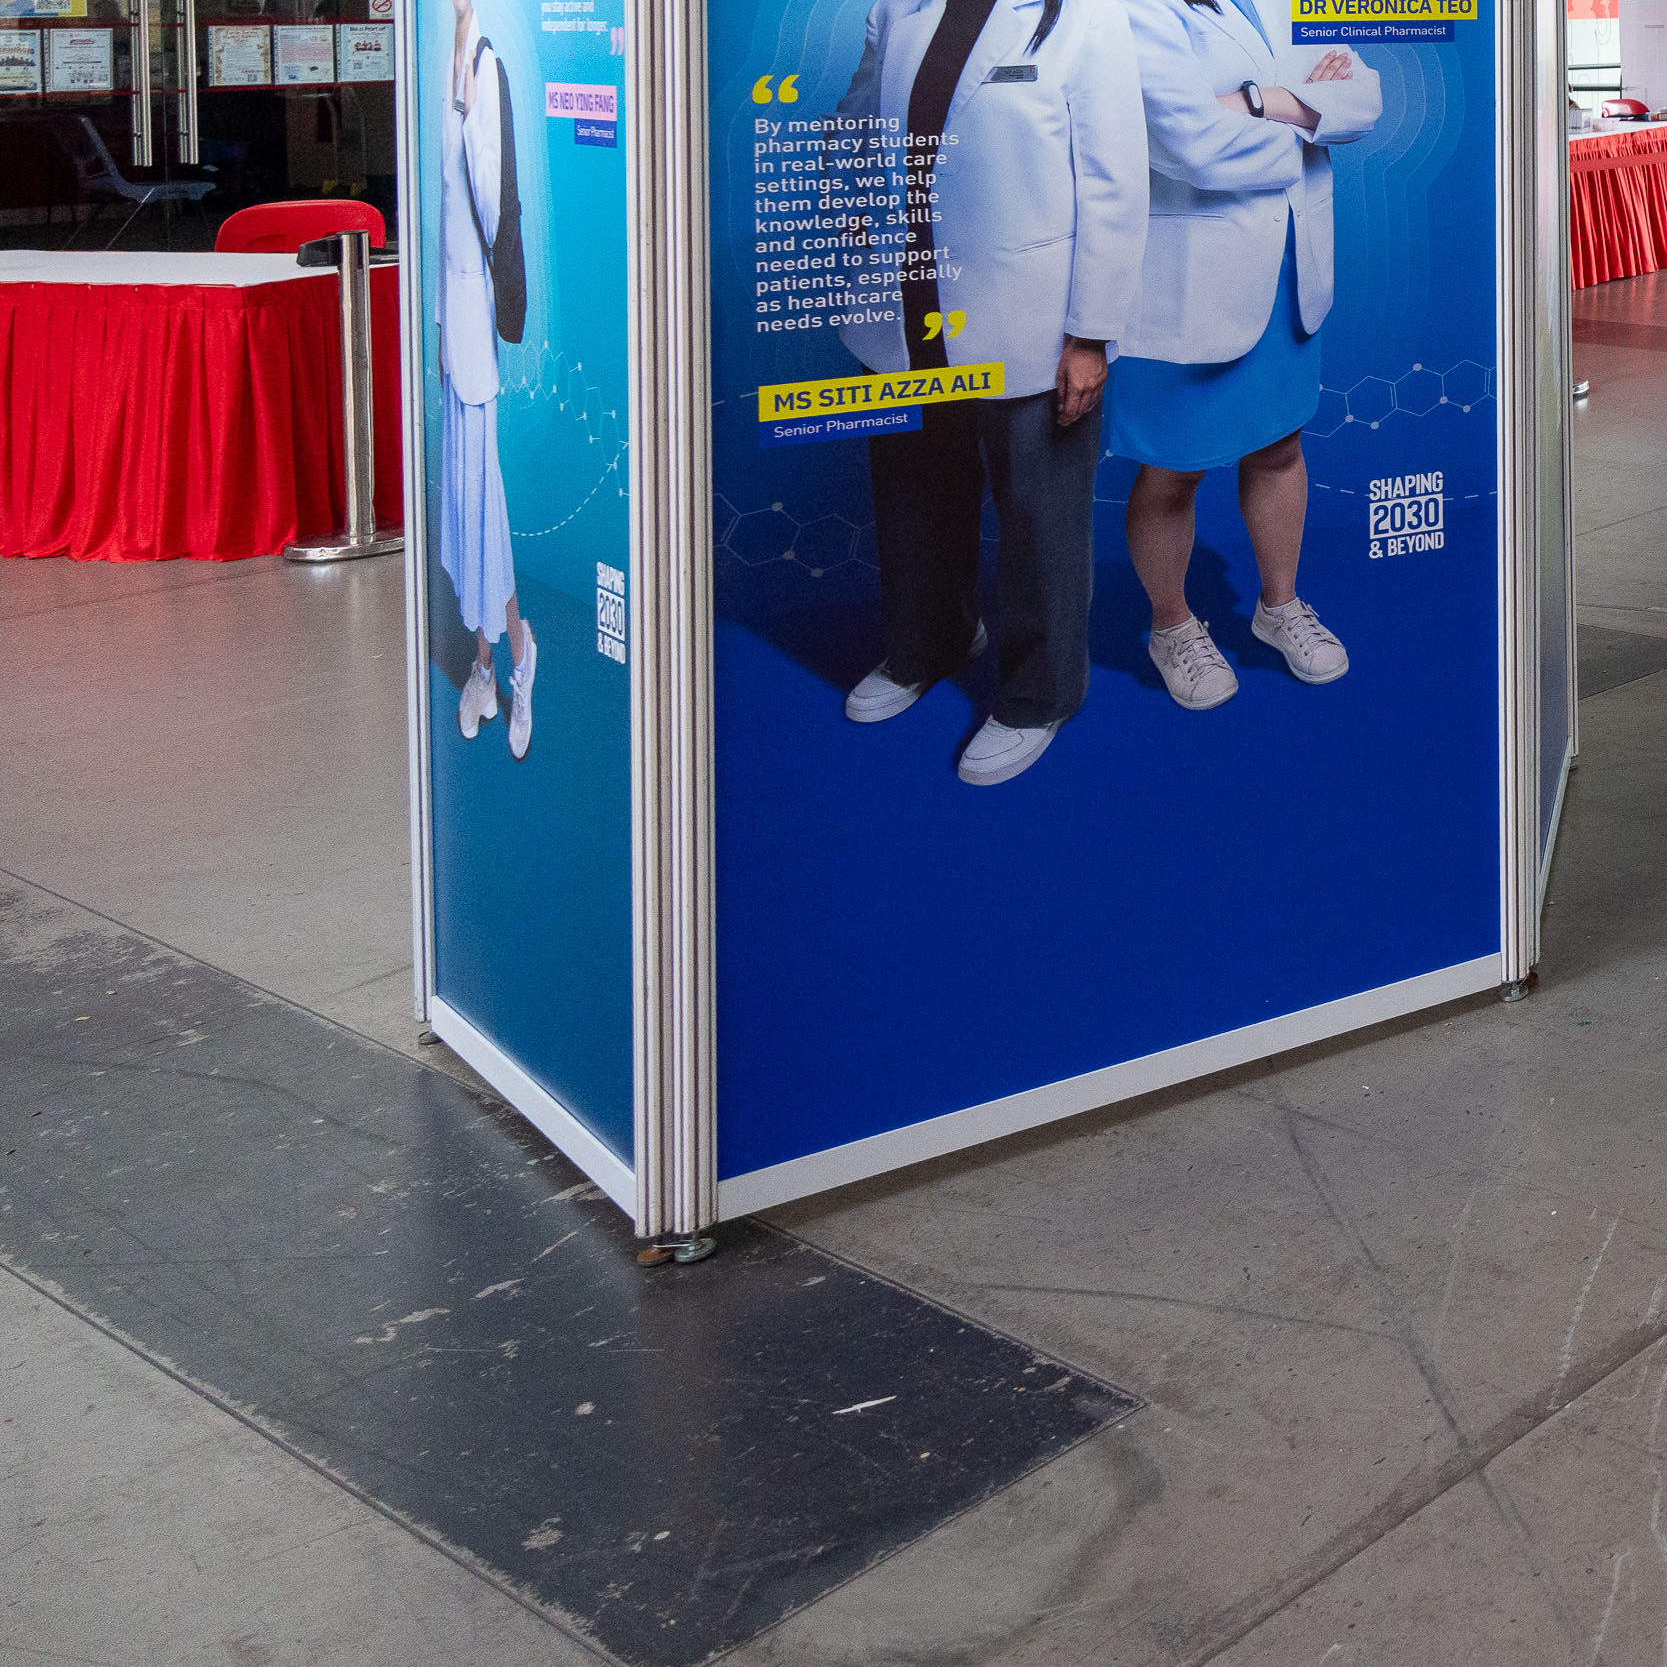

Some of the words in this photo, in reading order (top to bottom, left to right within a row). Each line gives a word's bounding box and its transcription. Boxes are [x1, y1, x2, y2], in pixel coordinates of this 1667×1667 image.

[1301, 26, 1338, 37] Senior
[1340, 26, 1382, 36] Clinical
[1384, 25, 1446, 36] Pharmacist
[560, 92, 574, 110] NEO
[575, 93, 593, 111] YING
[594, 94, 614, 113] FANG
[774, 391, 812, 412] MS
[818, 385, 873, 406] SITI
[879, 377, 945, 401] AZZA
[951, 372, 991, 393] ALI
[774, 423, 823, 438] Senior
[826, 413, 909, 432] Pharmacist
[600, 593, 622, 636] 2030
